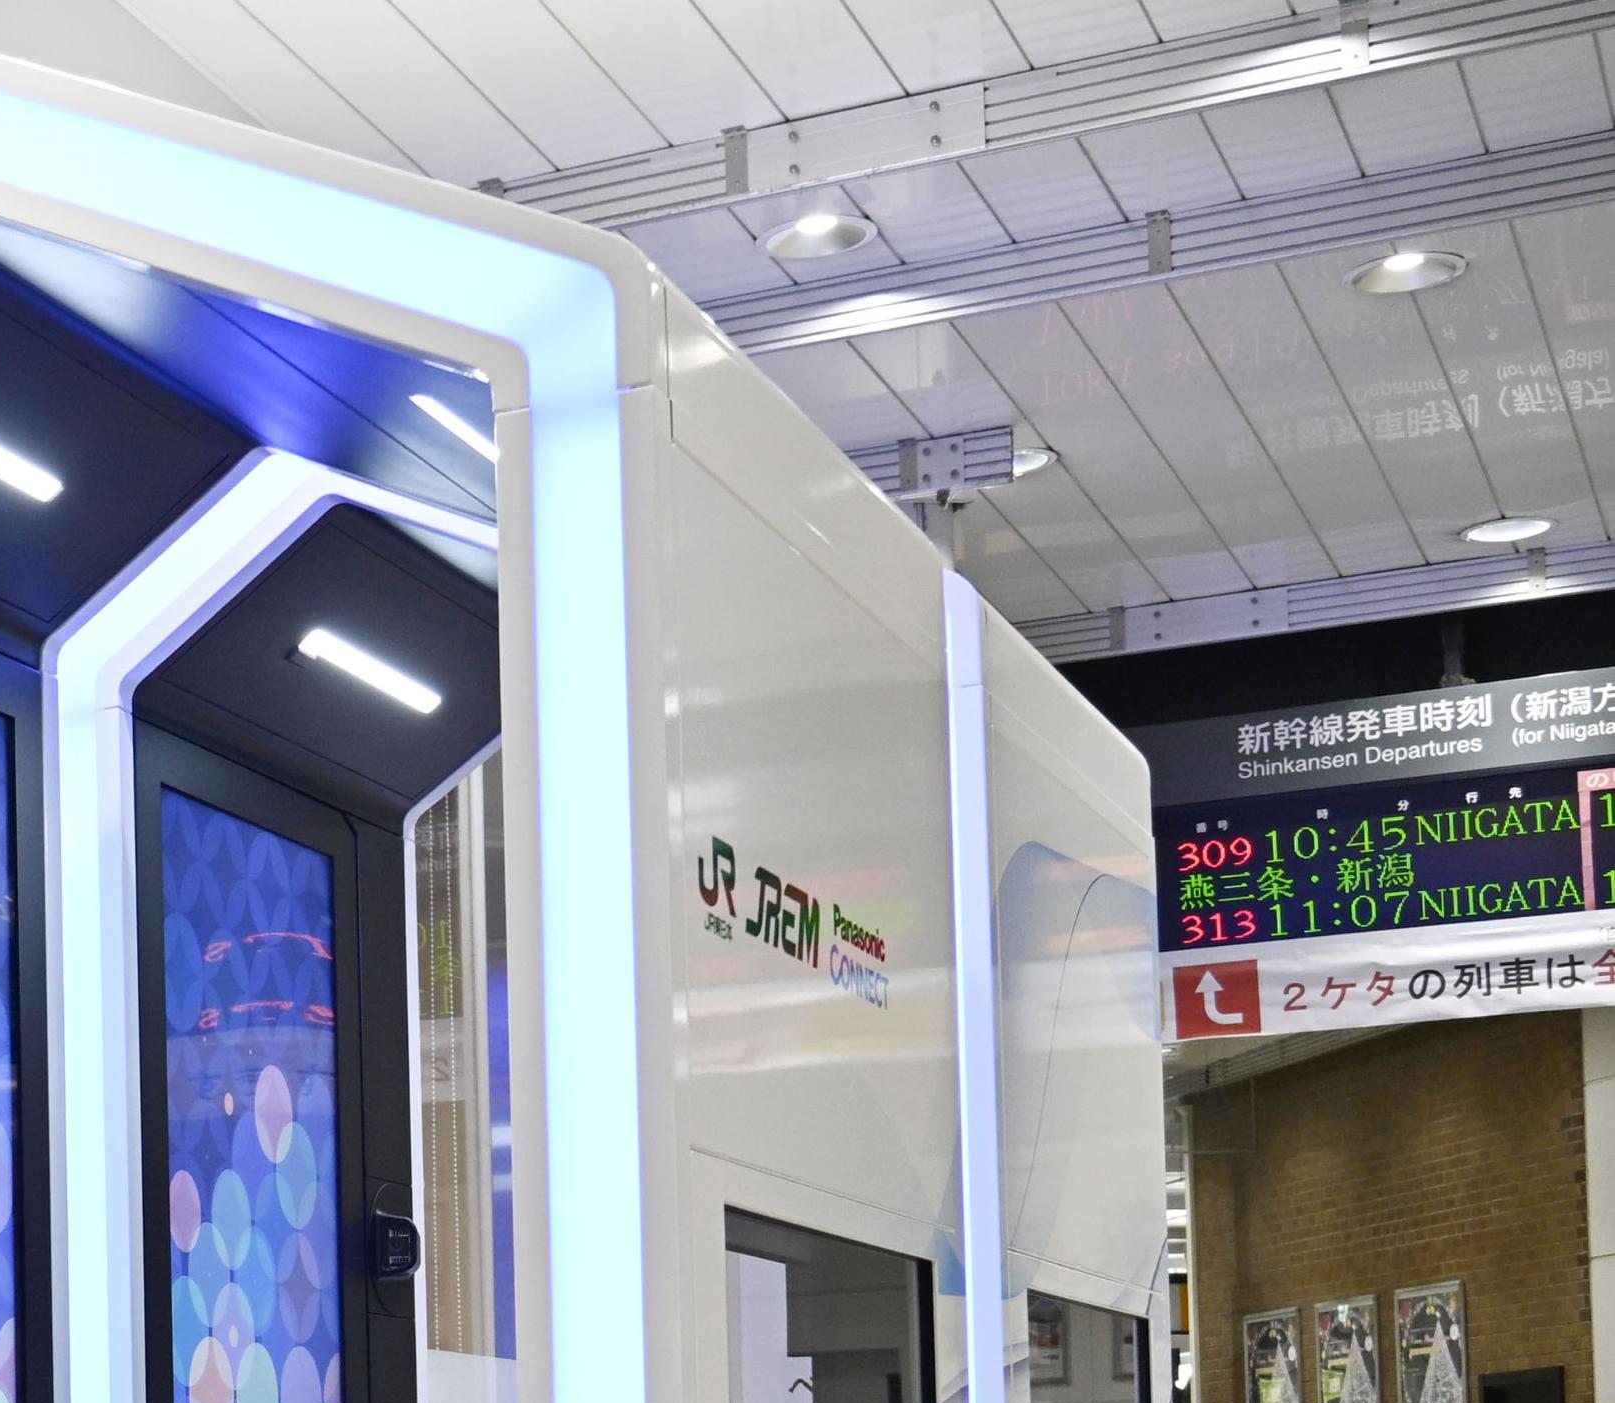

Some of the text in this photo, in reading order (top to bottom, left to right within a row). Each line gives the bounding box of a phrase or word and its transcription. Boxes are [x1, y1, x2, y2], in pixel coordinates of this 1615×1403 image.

[1237, 694, 1492, 756] 新幹線発車時刻
[1238, 751, 1358, 780] Shinkansen
[1364, 735, 1483, 767] Departures
[1512, 726, 1543, 747] (for
[1178, 836, 1253, 872] 309
[1266, 815, 1407, 864] 10:45
[1415, 799, 1581, 846] NIIGATA
[1397, 799, 1409, 812] 分
[698, 836, 736, 918] JR
[1181, 909, 1256, 944] 313
[1269, 891, 1410, 937] 11:07
[1419, 875, 1584, 921] NIIGATA
[746, 866, 820, 969] JREM
[833, 903, 885, 962] Panasonic
[830, 944, 889, 1010] CONNECT
